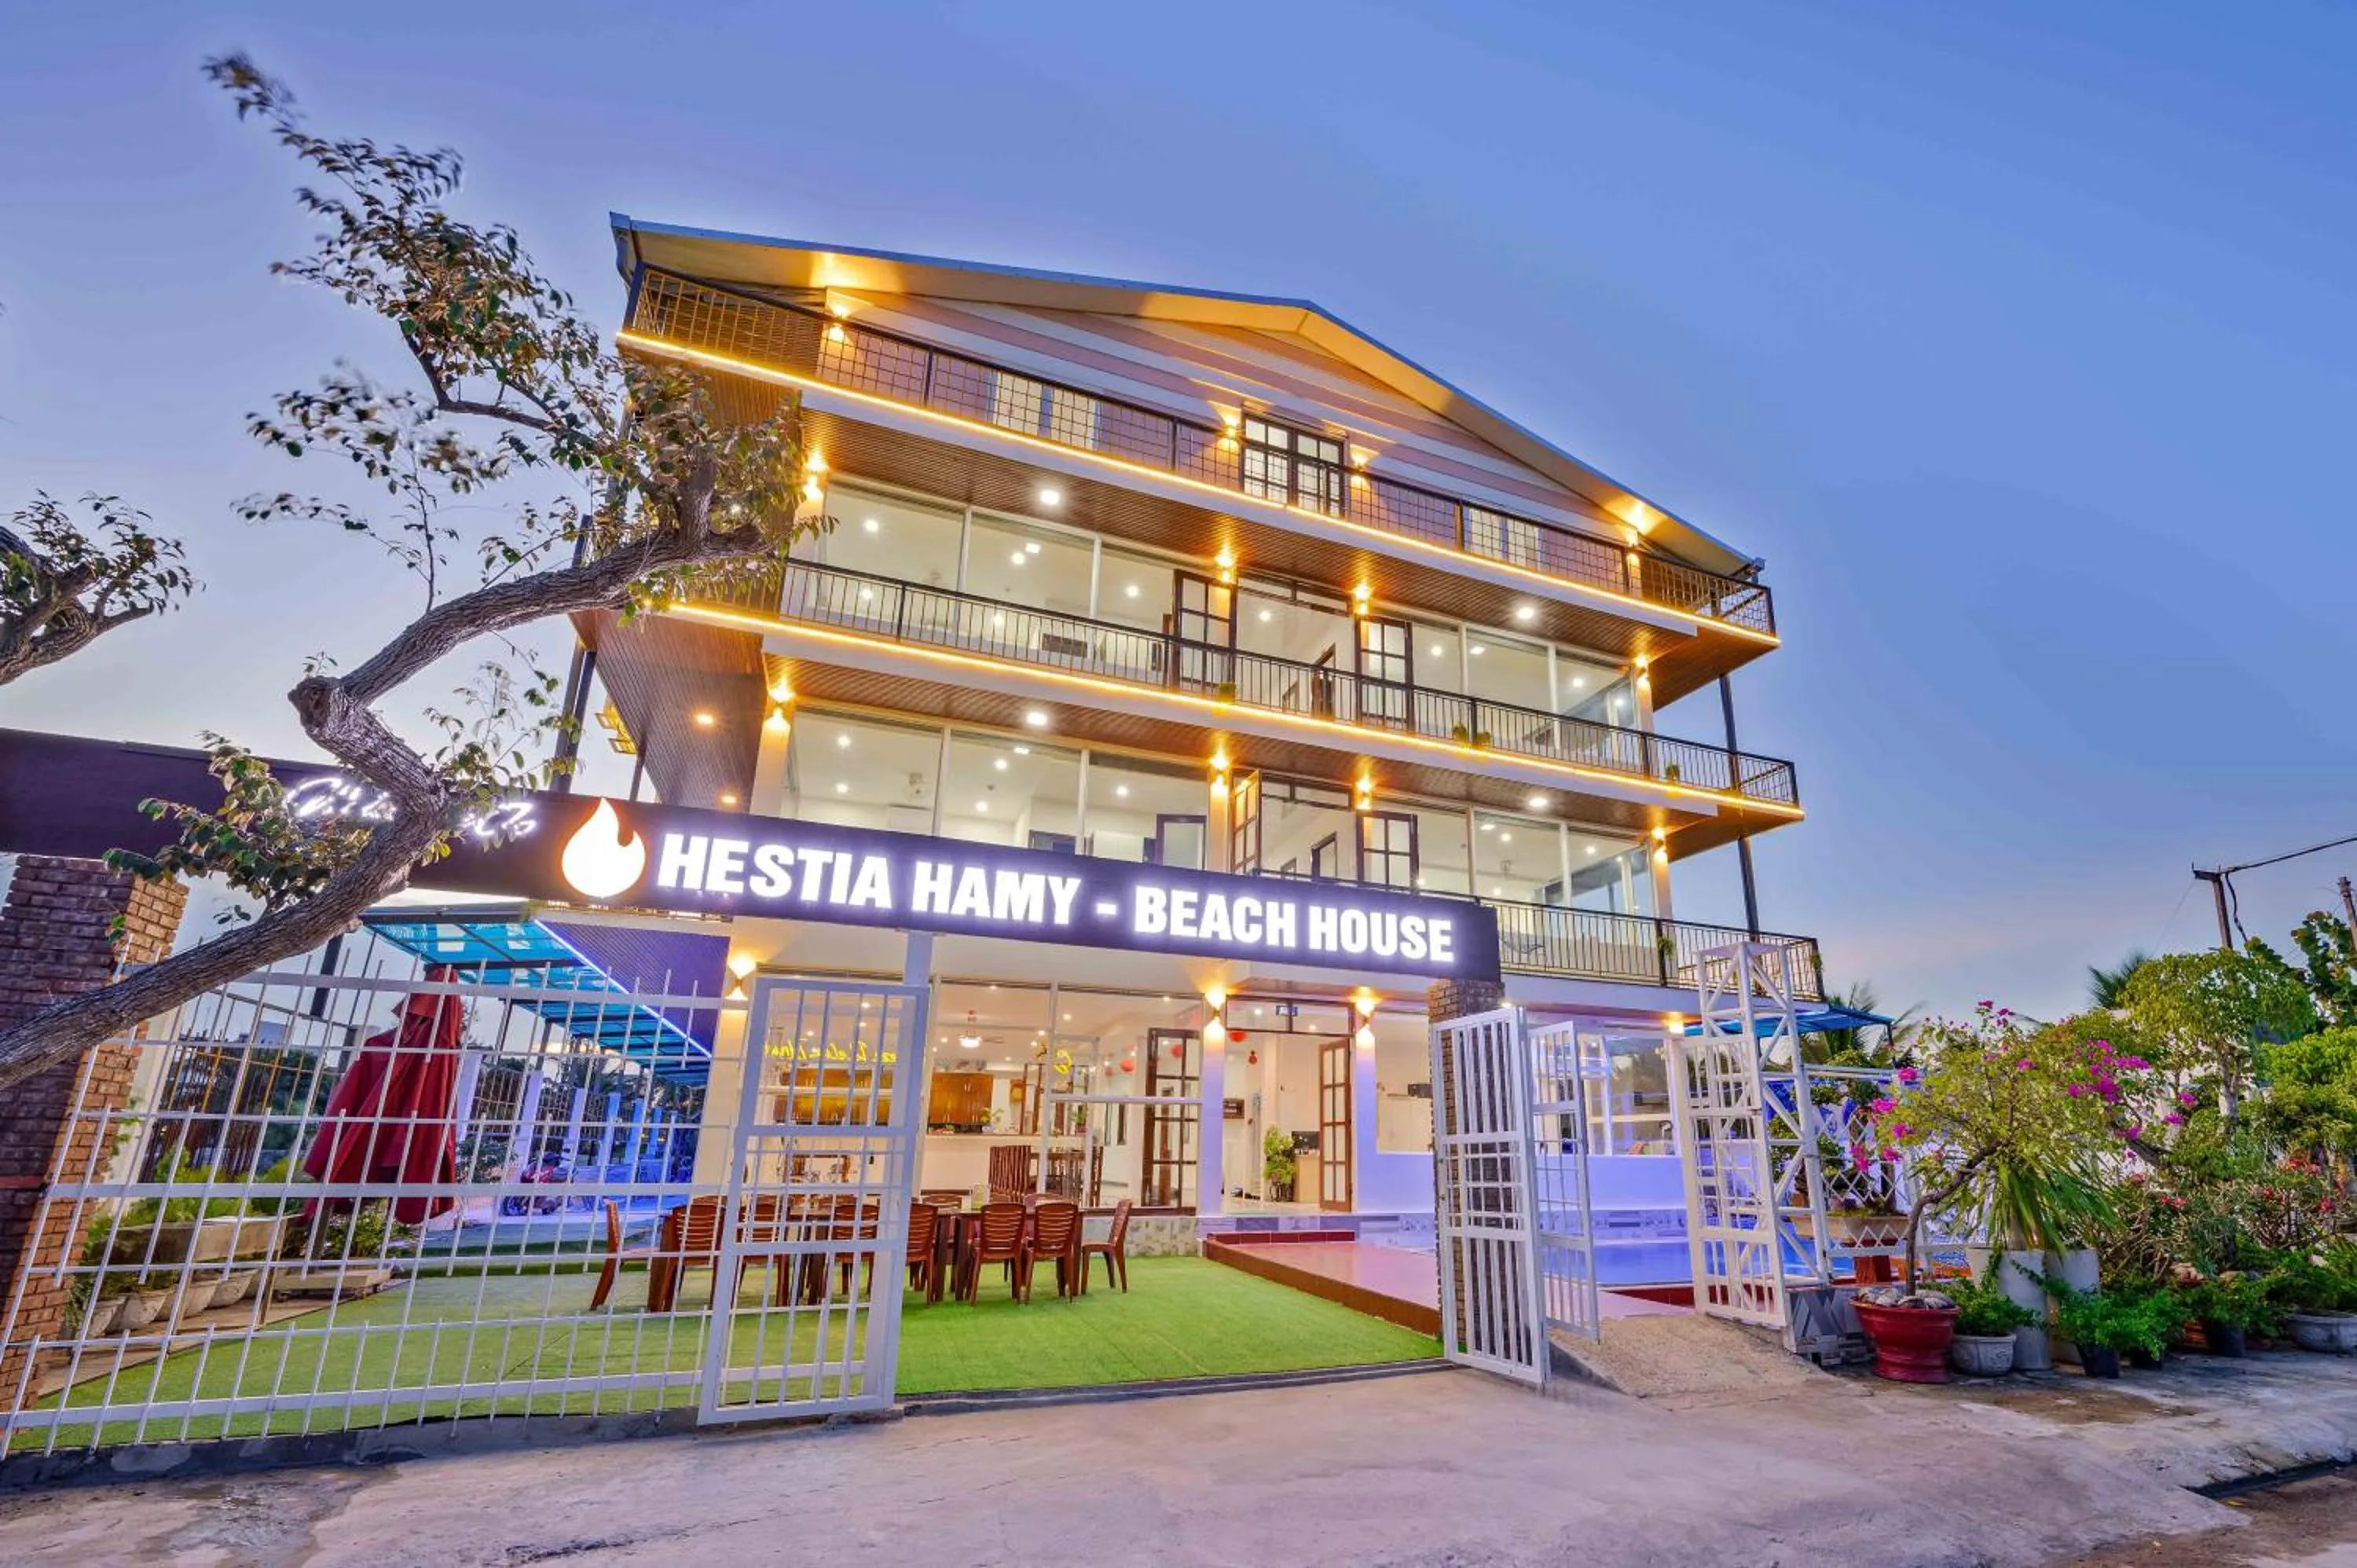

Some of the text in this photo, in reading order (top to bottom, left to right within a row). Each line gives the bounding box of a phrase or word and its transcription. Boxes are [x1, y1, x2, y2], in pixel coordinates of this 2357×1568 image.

[658, 833, 1454, 962] HESTIA HAMY - BEACH HOUSE
